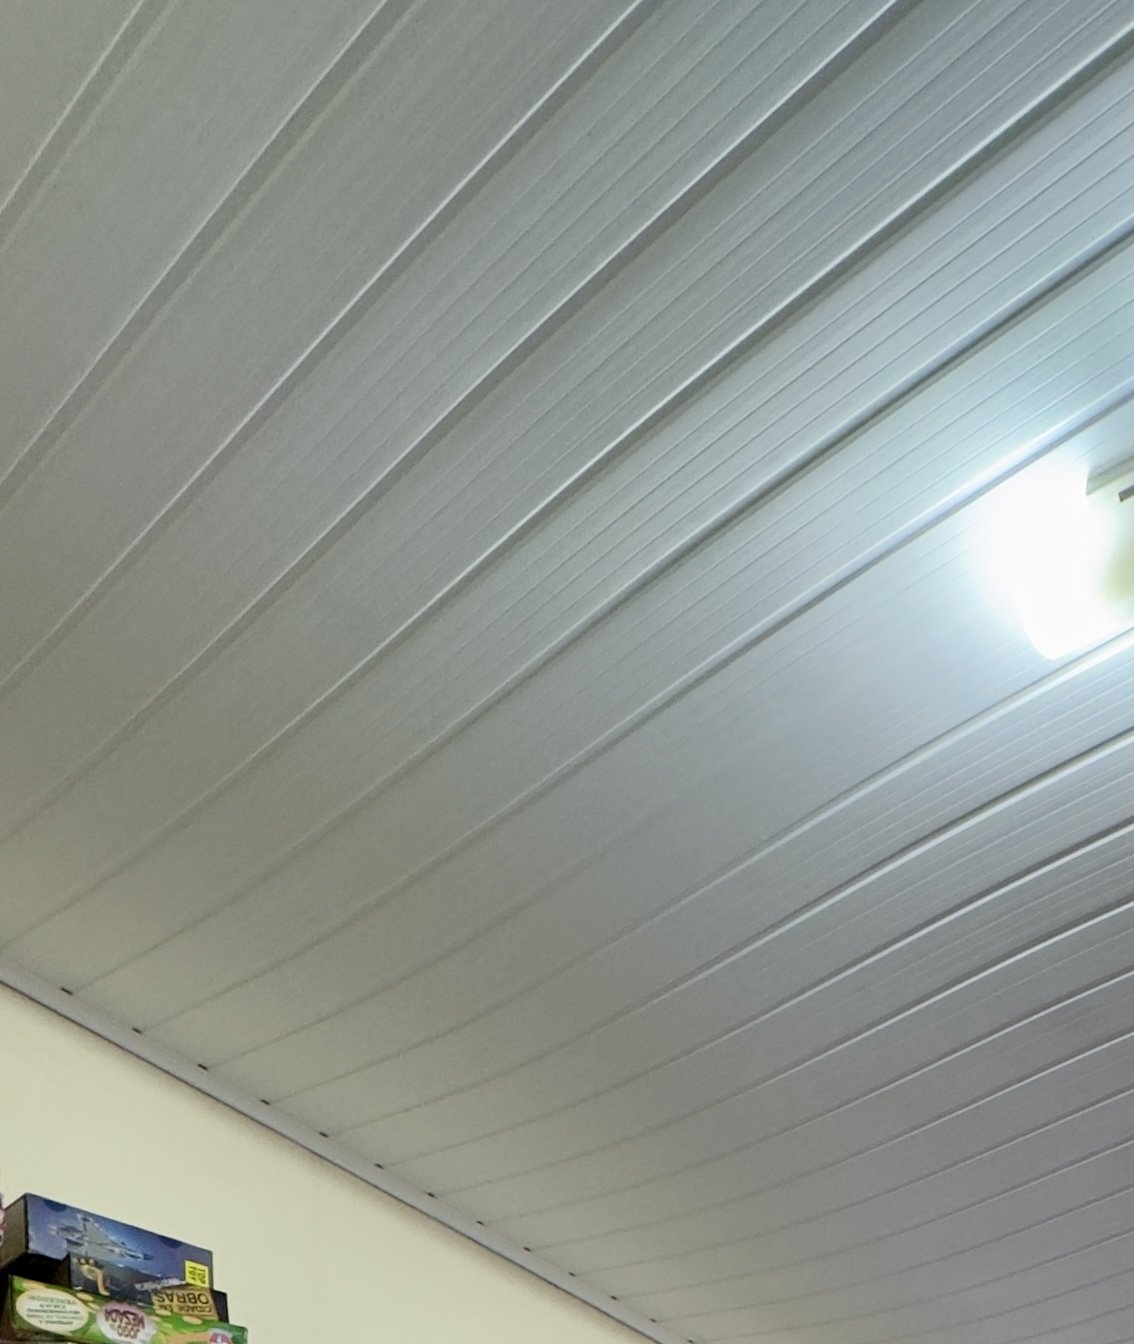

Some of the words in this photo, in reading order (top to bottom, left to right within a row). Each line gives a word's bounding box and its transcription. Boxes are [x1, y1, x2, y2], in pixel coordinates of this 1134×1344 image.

[154, 1290, 210, 1305] OBRAS
[104, 1309, 146, 1330] MESADA
[117, 1325, 140, 1340] JOGO
